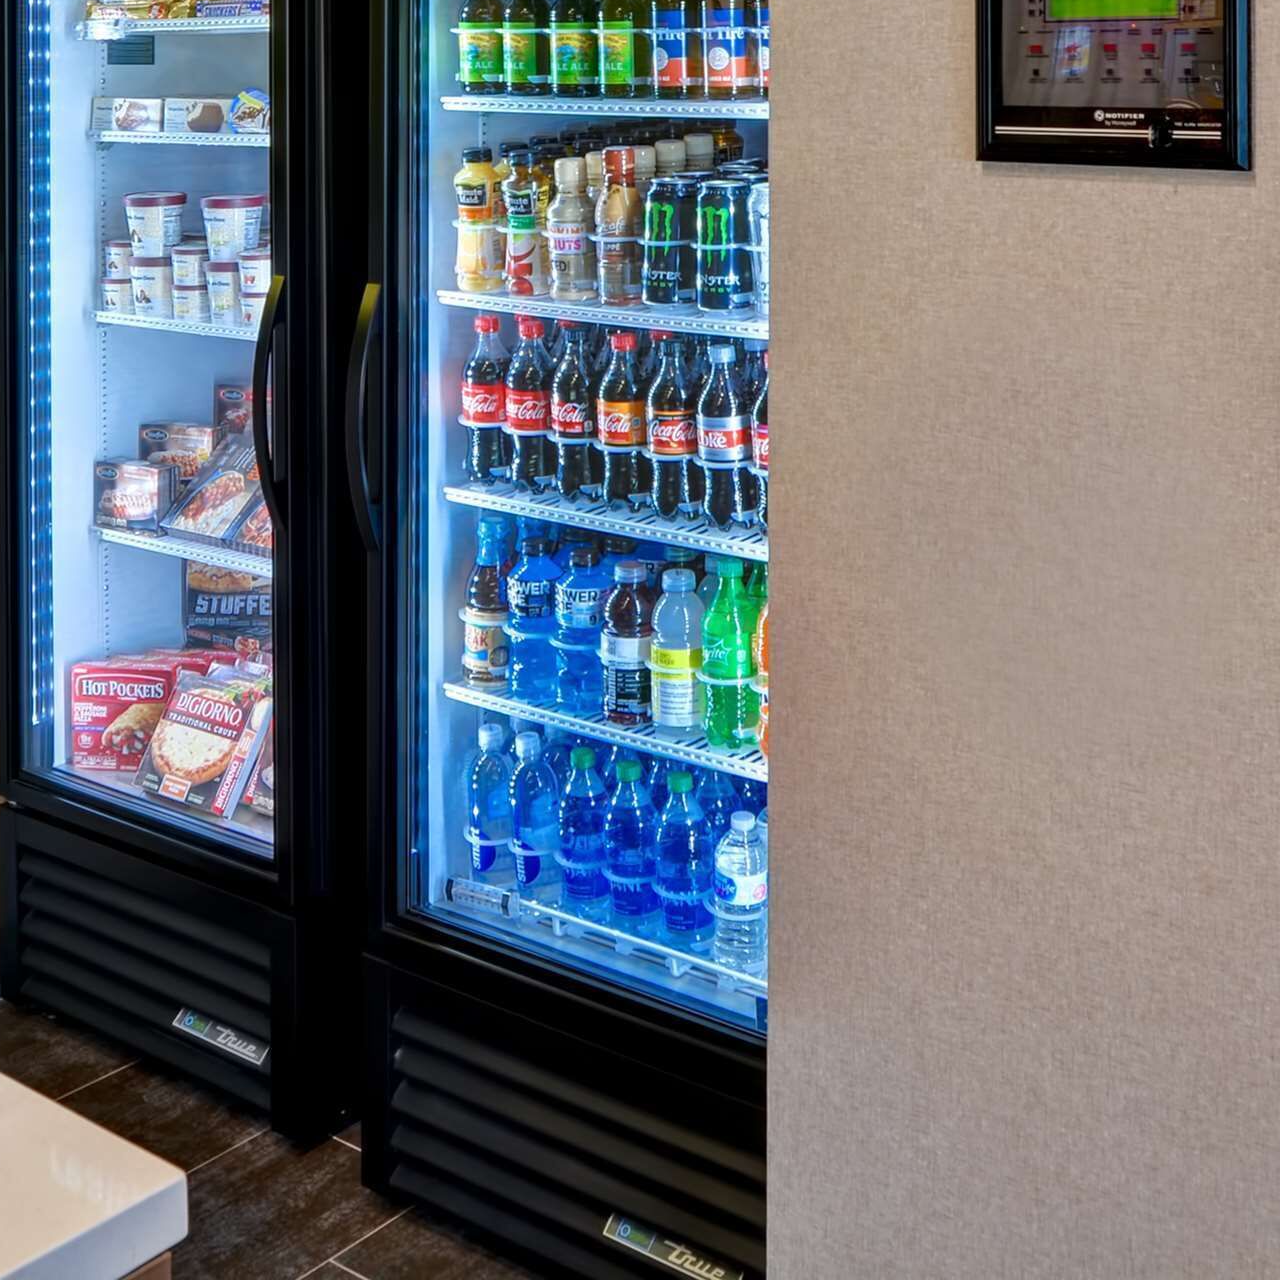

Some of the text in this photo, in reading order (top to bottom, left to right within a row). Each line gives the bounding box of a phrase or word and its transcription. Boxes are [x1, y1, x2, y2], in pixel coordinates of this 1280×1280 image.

[645, 270, 682, 282] NSTER
[701, 274, 741, 287] NSTER
[195, 594, 272, 616] STUFFE
[82, 680, 164, 699] HOT POCKETS
[176, 693, 242, 726] DIGIORNO
[169, 712, 238, 738] TRADITIONAL CRUST
